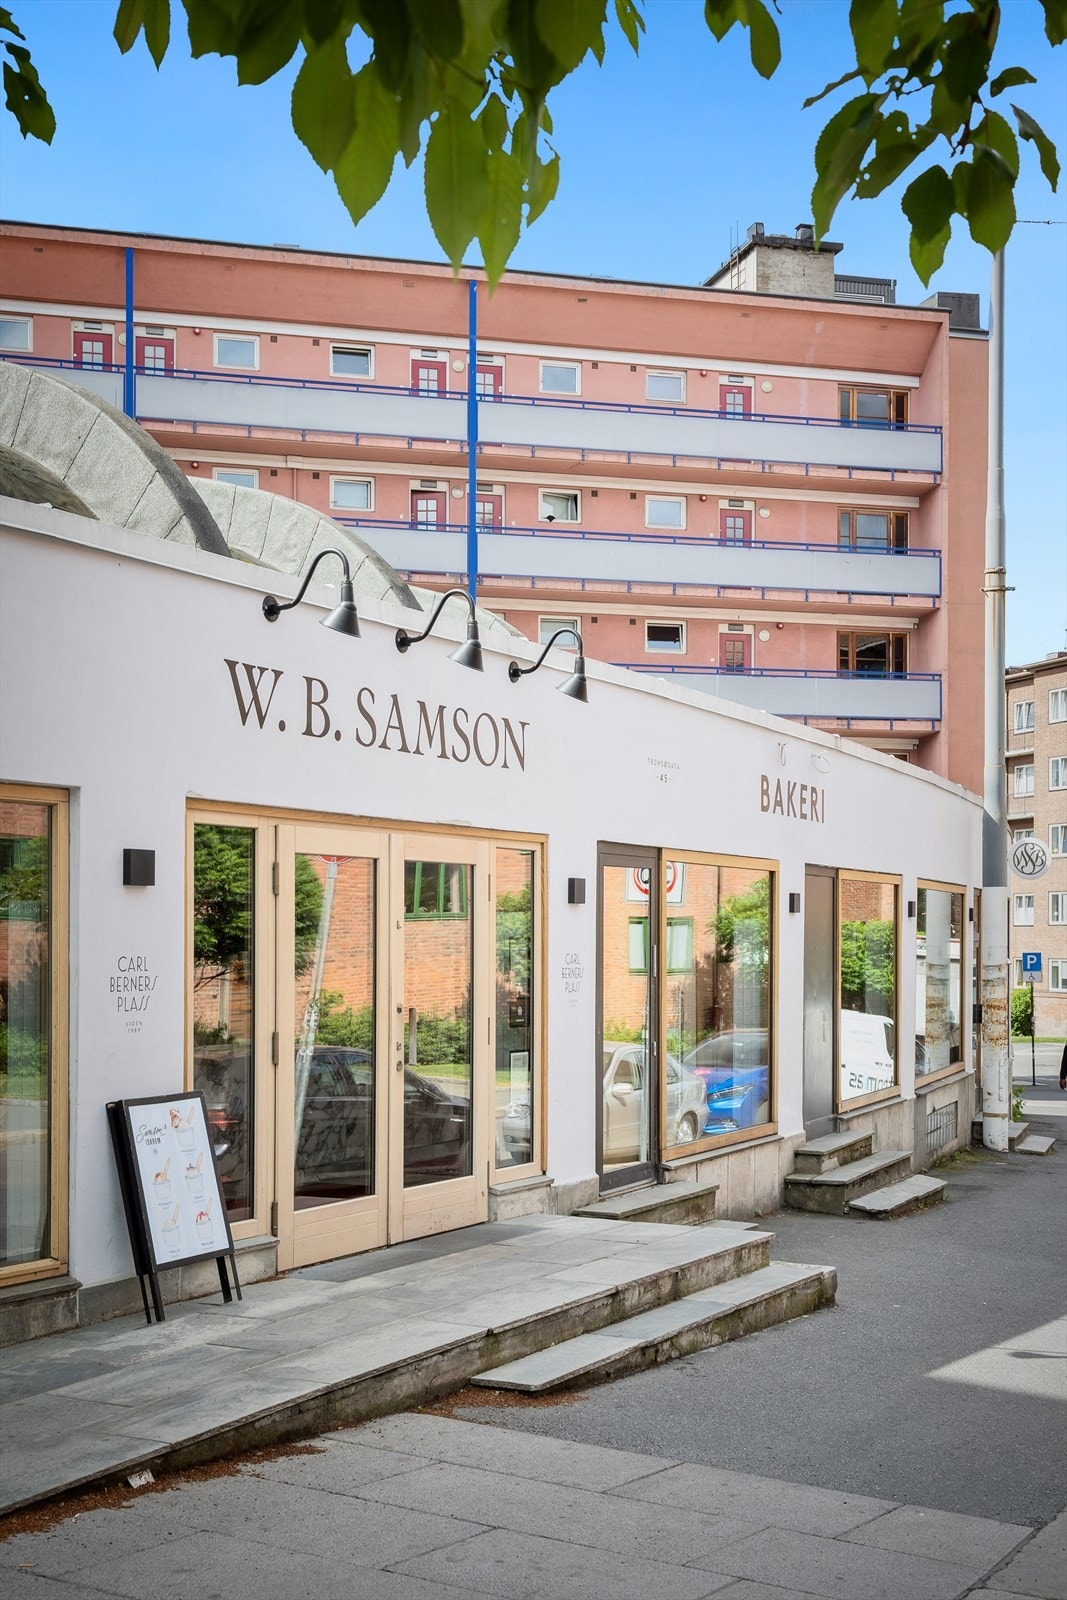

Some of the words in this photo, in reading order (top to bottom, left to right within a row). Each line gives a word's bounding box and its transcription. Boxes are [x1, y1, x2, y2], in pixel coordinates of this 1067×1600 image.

[223, 658, 286, 732] W.
[302, 675, 342, 742] B.
[355, 687, 530, 772] SAMSON
[760, 774, 825, 824] BAKERI
[117, 956, 148, 972] CARL
[1026, 955, 1037, 969] P
[109, 975, 158, 993] BERNERS
[117, 995, 150, 1013] PLASS
